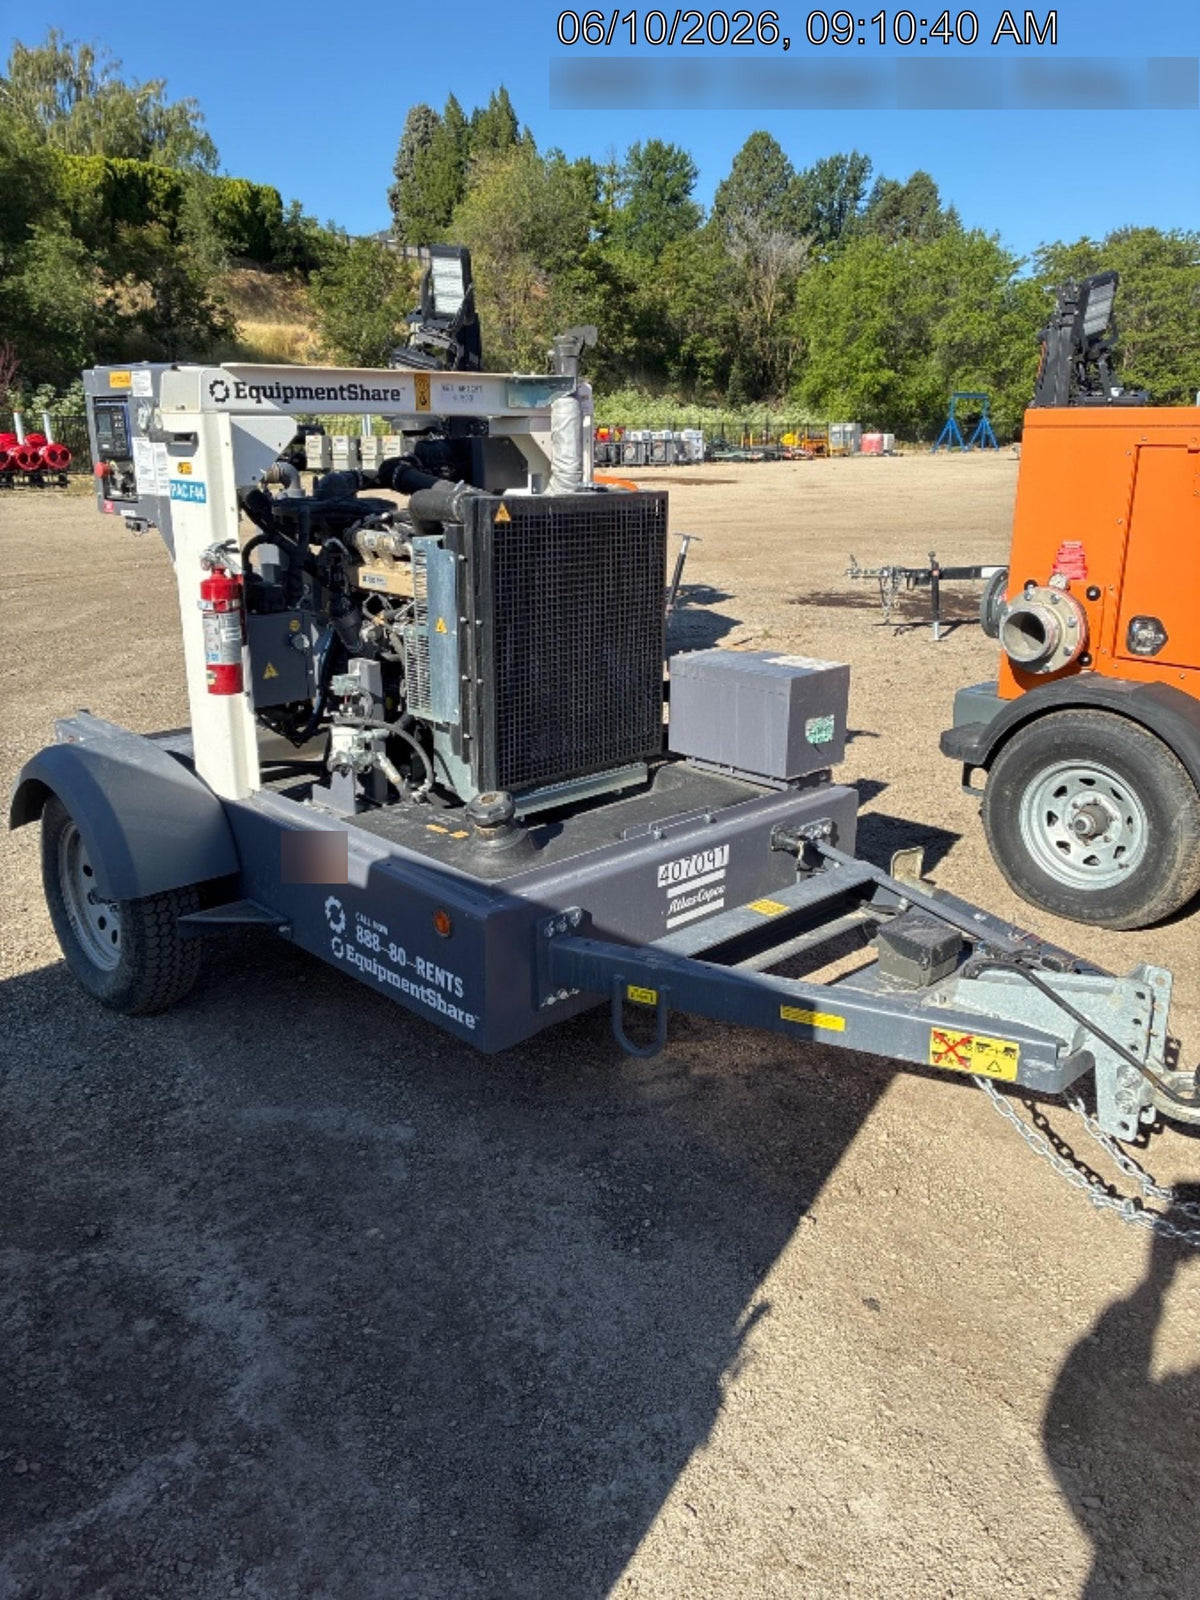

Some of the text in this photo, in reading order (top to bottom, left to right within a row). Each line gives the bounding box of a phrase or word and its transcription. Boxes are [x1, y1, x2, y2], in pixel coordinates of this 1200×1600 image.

[233, 382, 401, 403] EquipmentShare
[346, 944, 476, 1030] EquipmentShare
[356, 924, 464, 998] 888-80-RENTS
